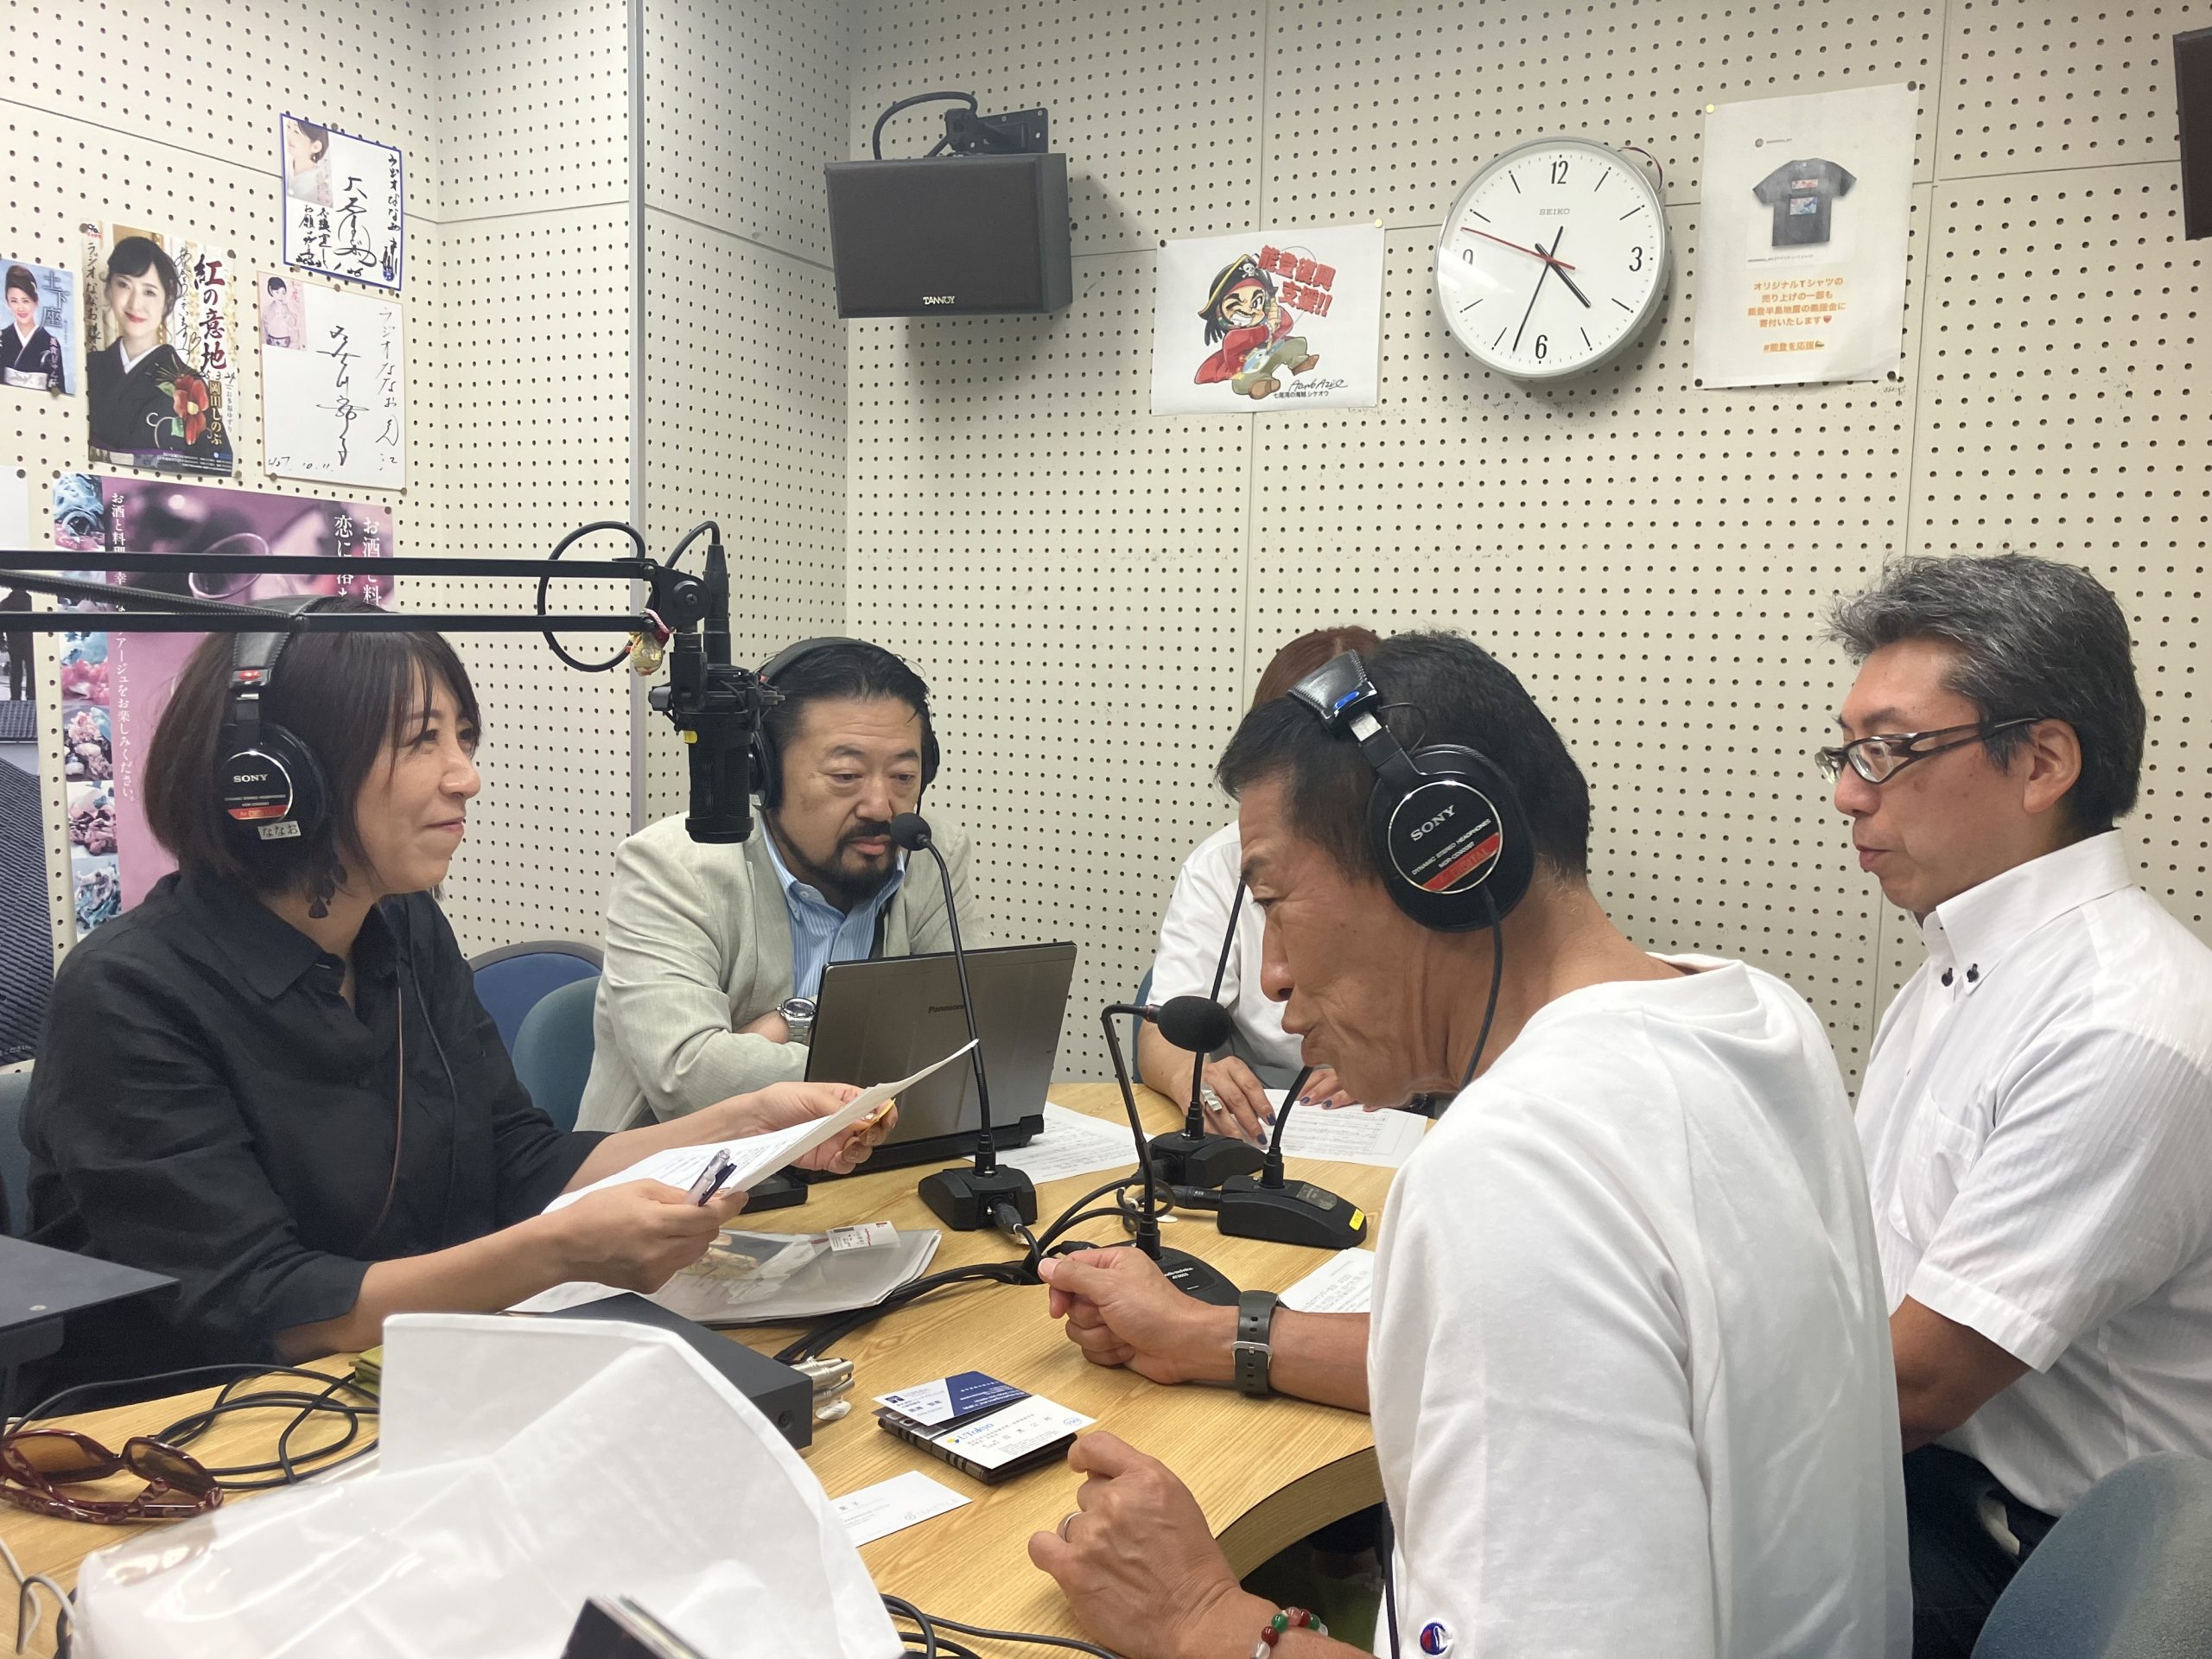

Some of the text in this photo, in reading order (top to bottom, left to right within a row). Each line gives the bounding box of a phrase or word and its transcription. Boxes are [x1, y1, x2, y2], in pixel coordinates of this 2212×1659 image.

[1551, 161, 1569, 184] 12
[1629, 246, 1643, 271] 3
[1754, 277, 1844, 290] オリジナルTシャツの
[40, 270, 71, 332] 土下座
[923, 296, 956, 305] TANNOY
[1762, 290, 1834, 302] 売り上げの一部も
[194, 253, 227, 373] 紅の意地
[1759, 316, 1821, 327] 寄付いたします
[1535, 334, 1548, 359] 6
[233, 773, 269, 783] SONY
[262, 823, 298, 837] ななお
[1410, 804, 1456, 842] SONY
[927, 1004, 965, 1014] Panasoni
